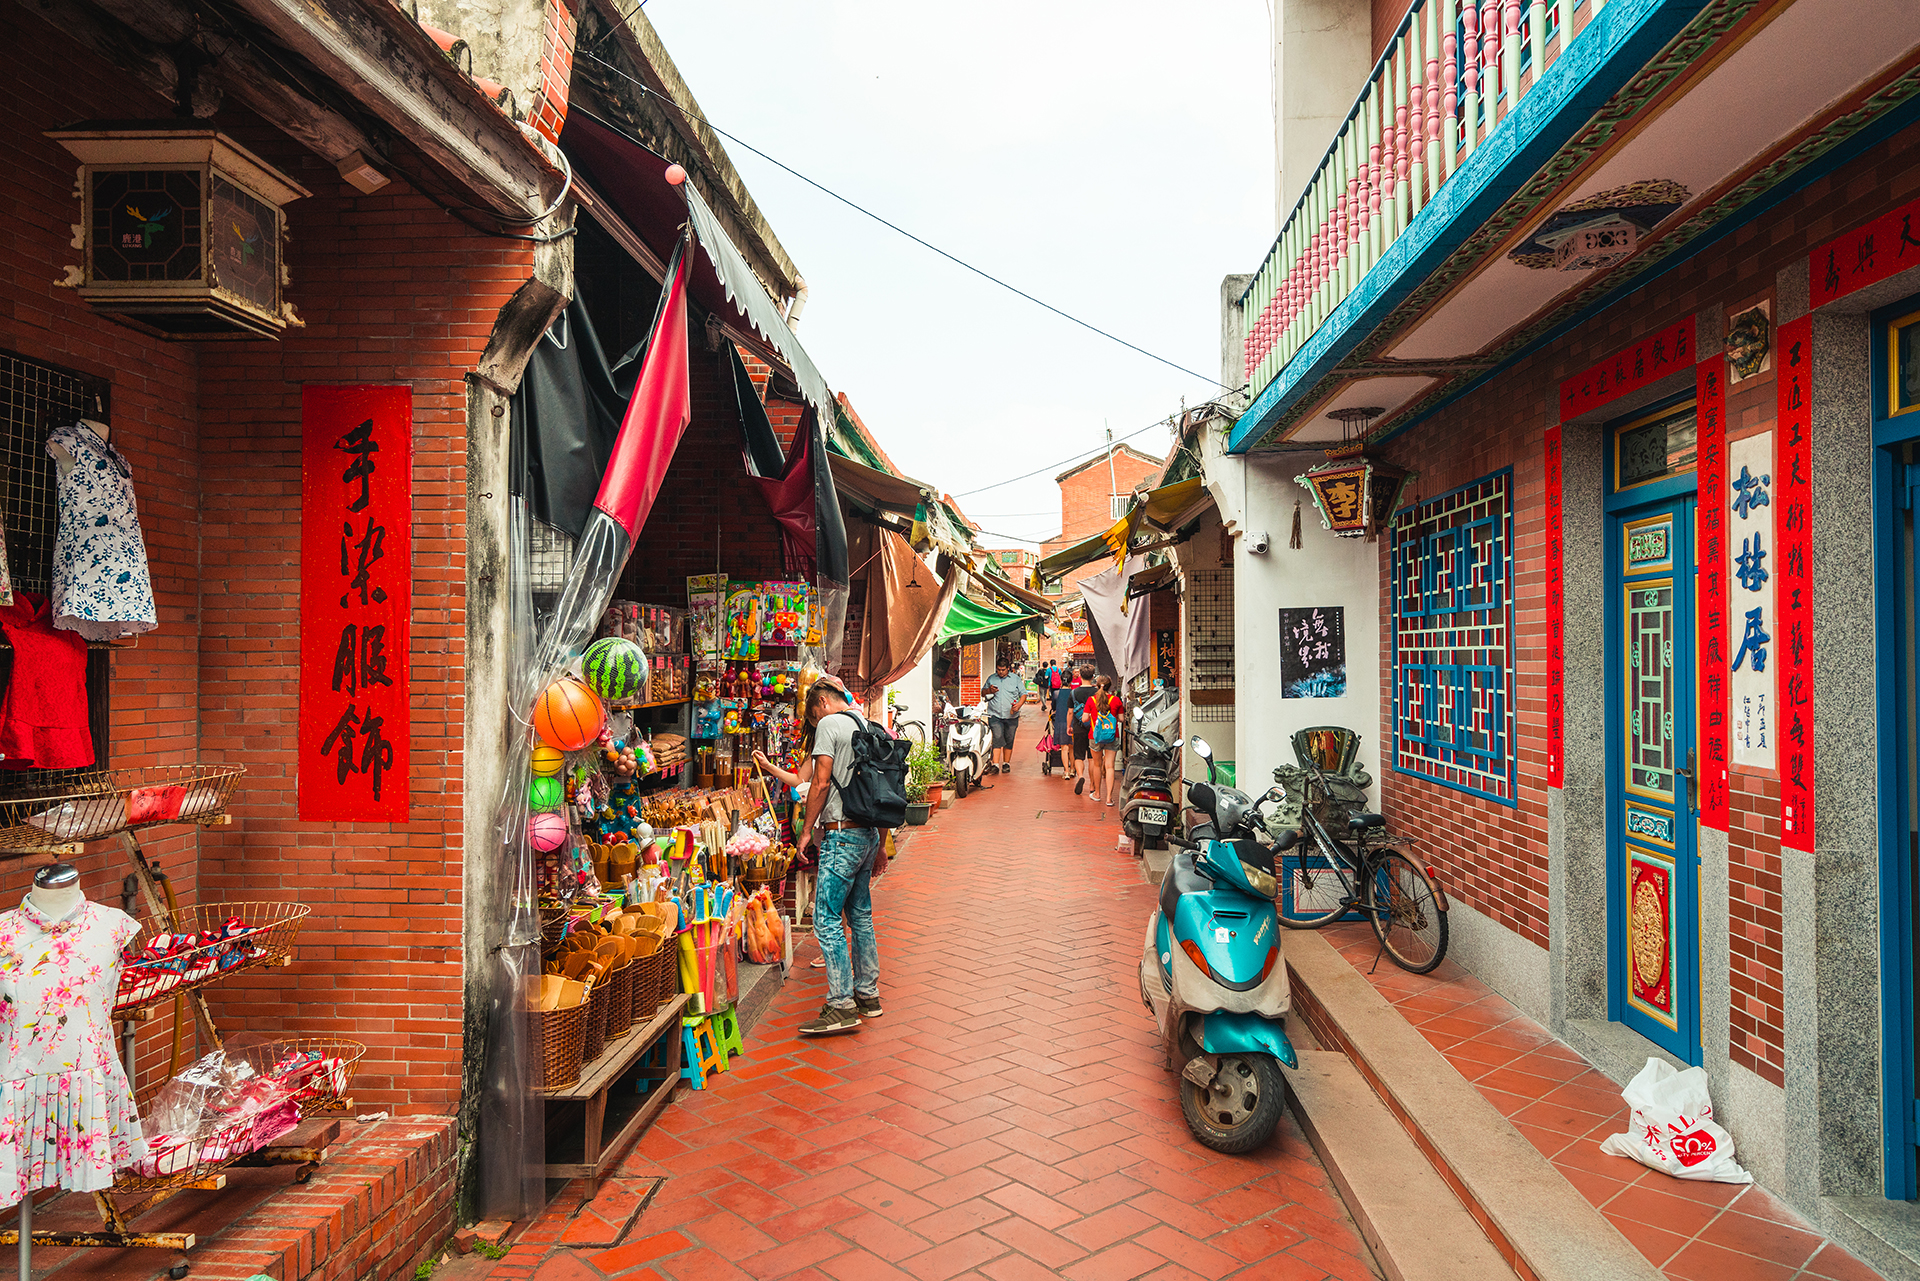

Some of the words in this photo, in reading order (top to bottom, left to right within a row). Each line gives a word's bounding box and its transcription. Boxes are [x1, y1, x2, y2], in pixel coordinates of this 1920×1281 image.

[1325, 481, 1358, 518] 李
[1731, 465, 1770, 672] 松林居
[320, 418, 394, 802] 手染服飾
